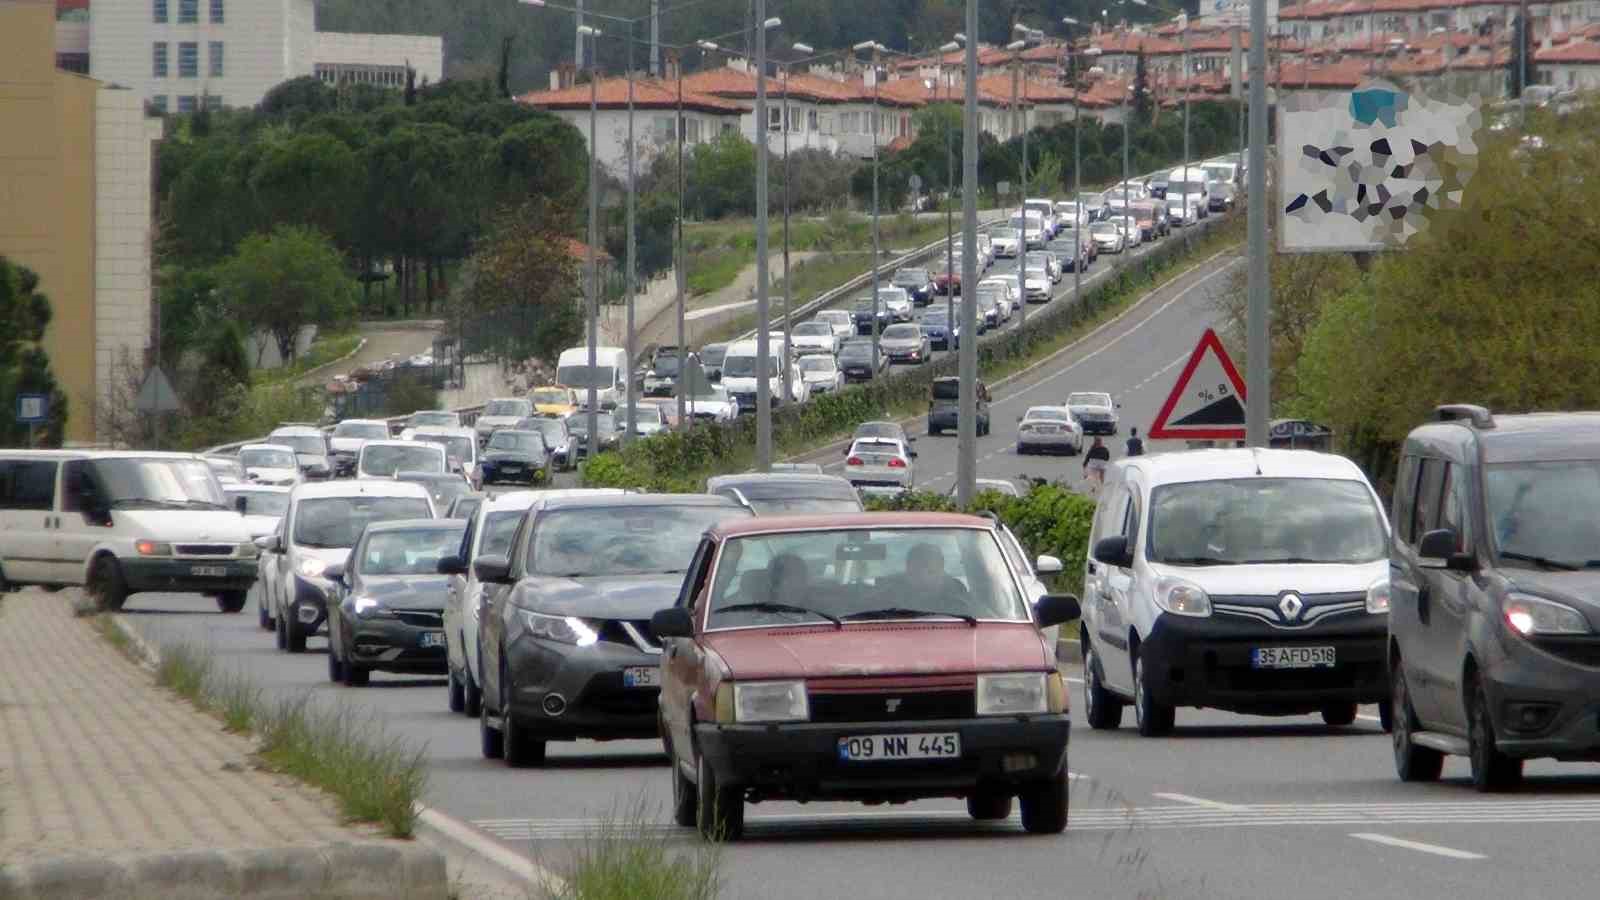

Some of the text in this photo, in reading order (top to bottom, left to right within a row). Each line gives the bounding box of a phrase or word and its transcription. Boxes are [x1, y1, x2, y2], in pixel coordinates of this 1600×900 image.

[1260, 649, 1277, 664] 35
[635, 668, 650, 684] 35
[849, 738, 874, 757] 09
[882, 736, 908, 756] NN
[918, 735, 956, 754] 445
